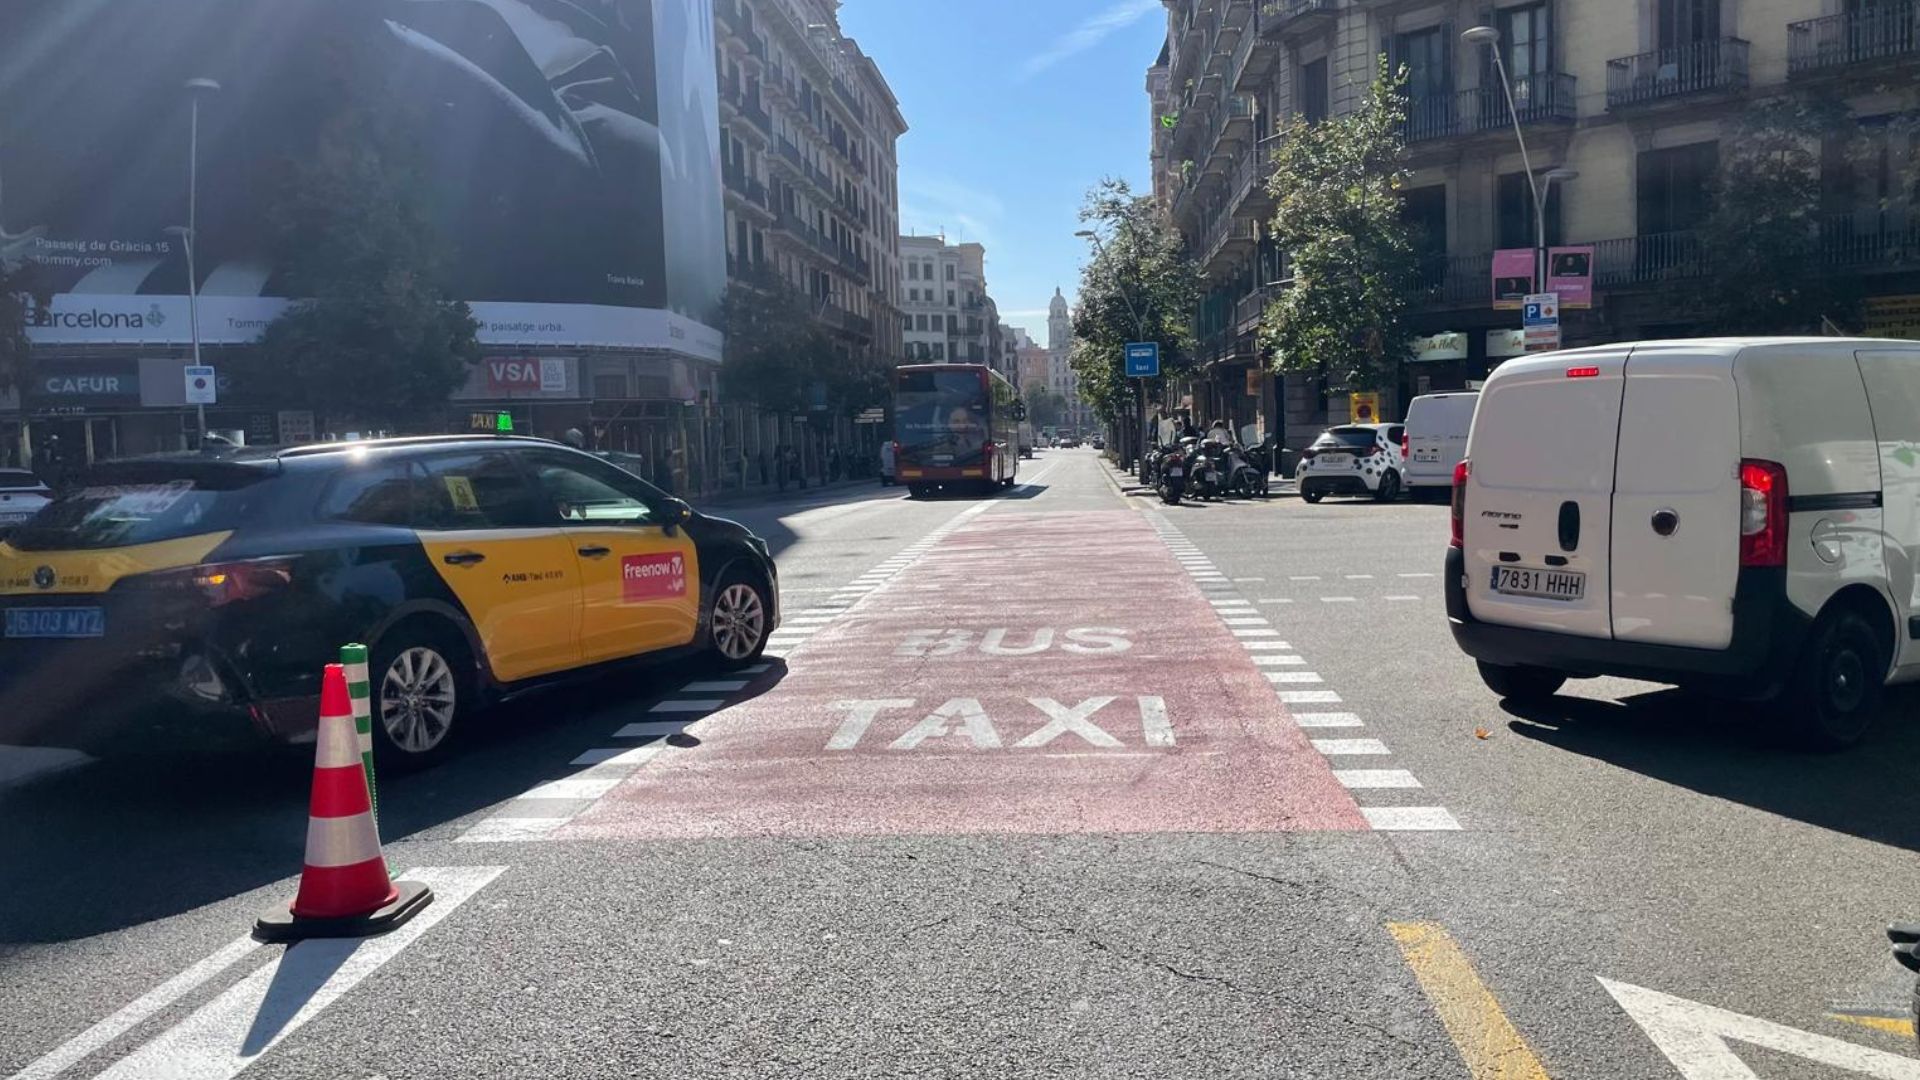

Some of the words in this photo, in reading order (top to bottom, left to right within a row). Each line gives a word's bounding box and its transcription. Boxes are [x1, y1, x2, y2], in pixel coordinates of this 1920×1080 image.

[34, 237, 87, 253] Passeig
[89, 239, 106, 251] de
[154, 241, 170, 253] 15
[35, 254, 112, 268] tommy.com
[24, 308, 143, 328] Barcelona
[1527, 305, 1537, 317] P
[491, 319, 535, 333] paisatge
[45, 377, 119, 393] CAFUR
[471, 412, 495, 429] TAXI
[1499, 569, 1540, 591] 7831
[1546, 574, 1581, 596] HHH
[900, 627, 1134, 656] BUS
[824, 695, 1177, 750] TAXI
